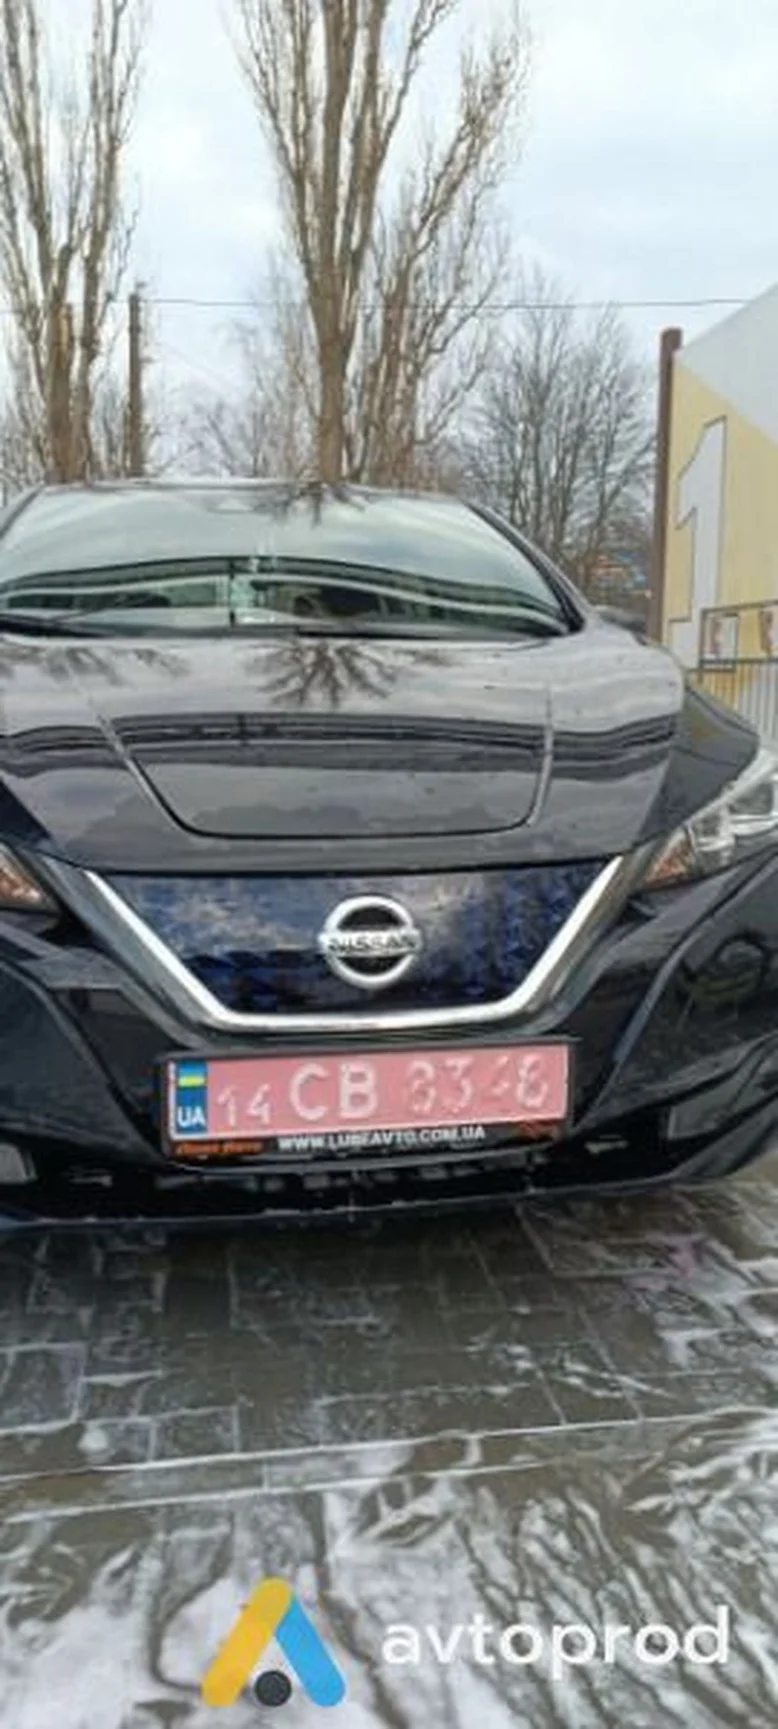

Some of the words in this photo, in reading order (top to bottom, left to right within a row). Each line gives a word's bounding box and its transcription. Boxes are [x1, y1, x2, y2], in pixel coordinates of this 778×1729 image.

[217, 1083, 272, 1127] 14
[289, 1061, 379, 1121] CB
[177, 1106, 206, 1127] UA
